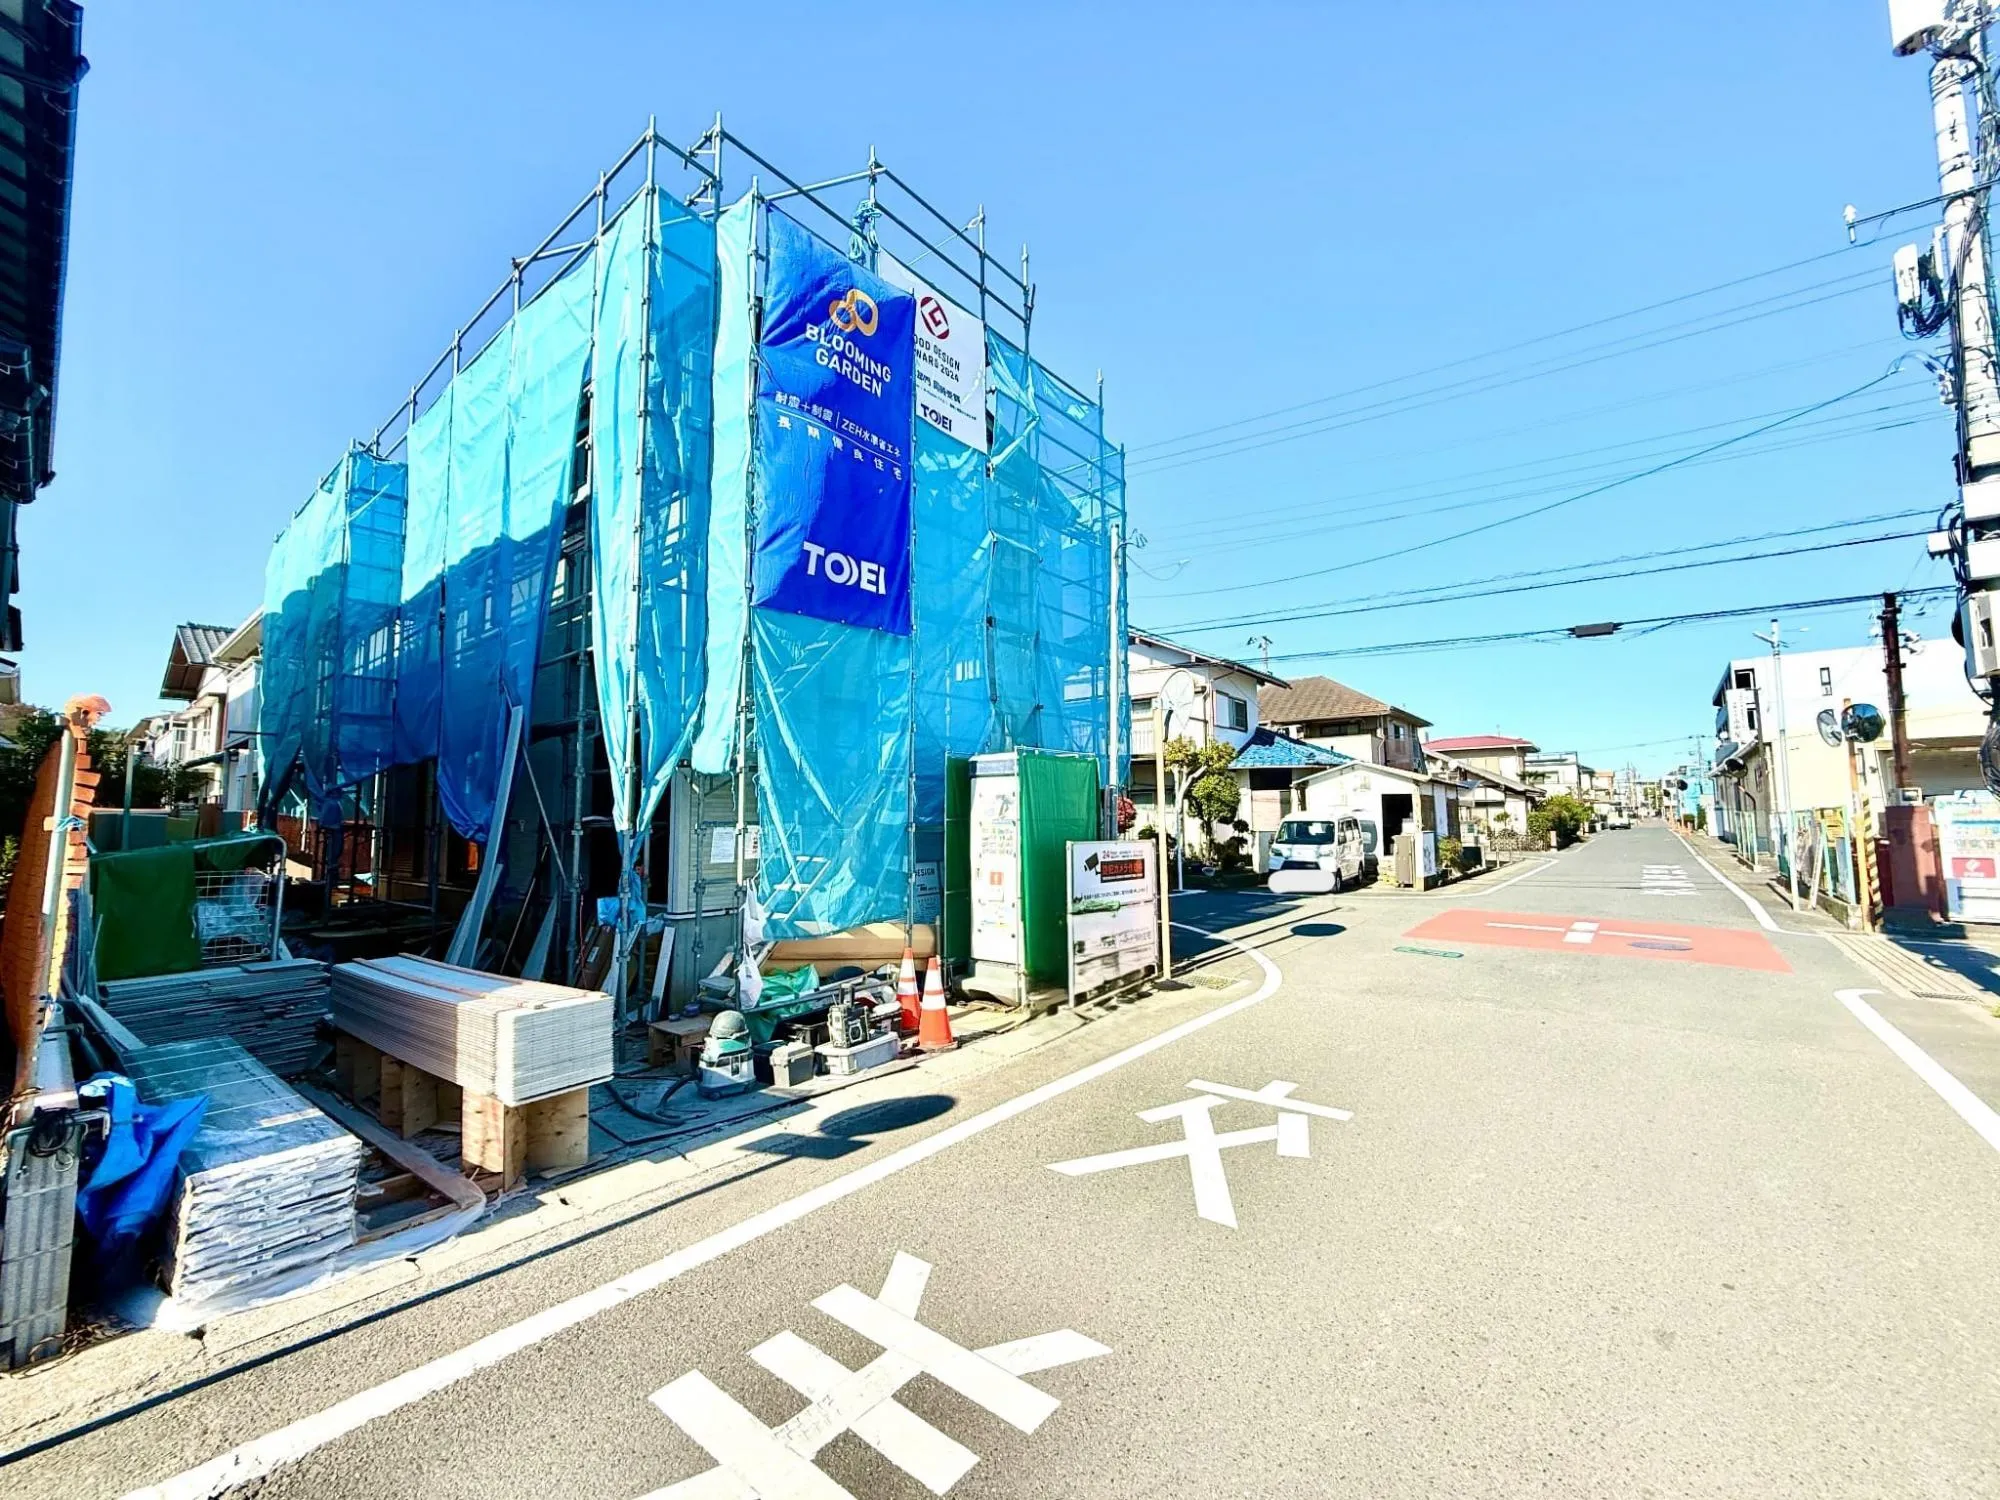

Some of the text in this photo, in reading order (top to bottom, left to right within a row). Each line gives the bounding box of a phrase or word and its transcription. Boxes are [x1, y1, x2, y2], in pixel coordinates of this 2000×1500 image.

[805, 323, 892, 383] BLOOMING
[815, 350, 883, 398] GARDEN
[914, 334, 961, 372] OOD DESIGN
[914, 349, 960, 383] WARD 2024
[776, 415, 903, 480] 長期優良住宅
[802, 540, 886, 595] TOEI
